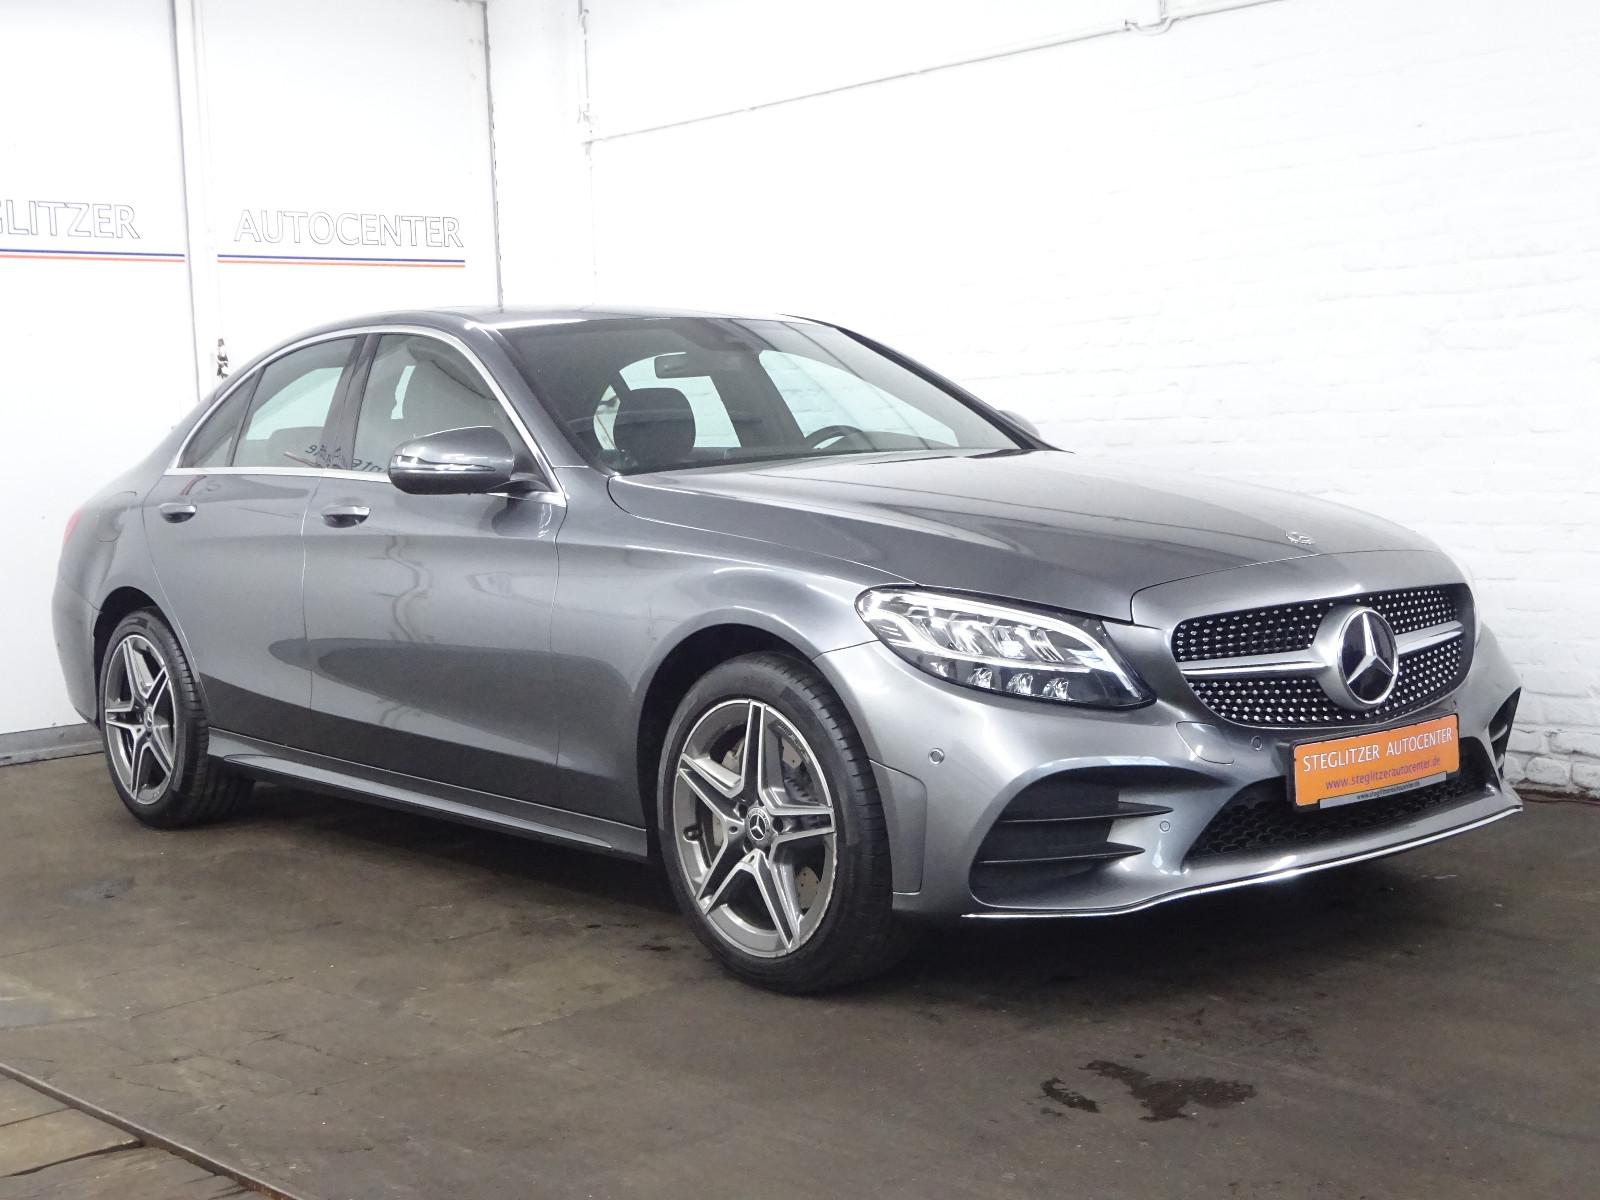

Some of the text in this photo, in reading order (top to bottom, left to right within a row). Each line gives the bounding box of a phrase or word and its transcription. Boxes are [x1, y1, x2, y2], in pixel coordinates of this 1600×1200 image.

[0, 200, 464, 249] LITZER AUTOCENTER
[1303, 727, 1453, 772] STEGLITZER AUTOCENTER
[1325, 756, 1441, 790] www.steglitzerautocenter.de
